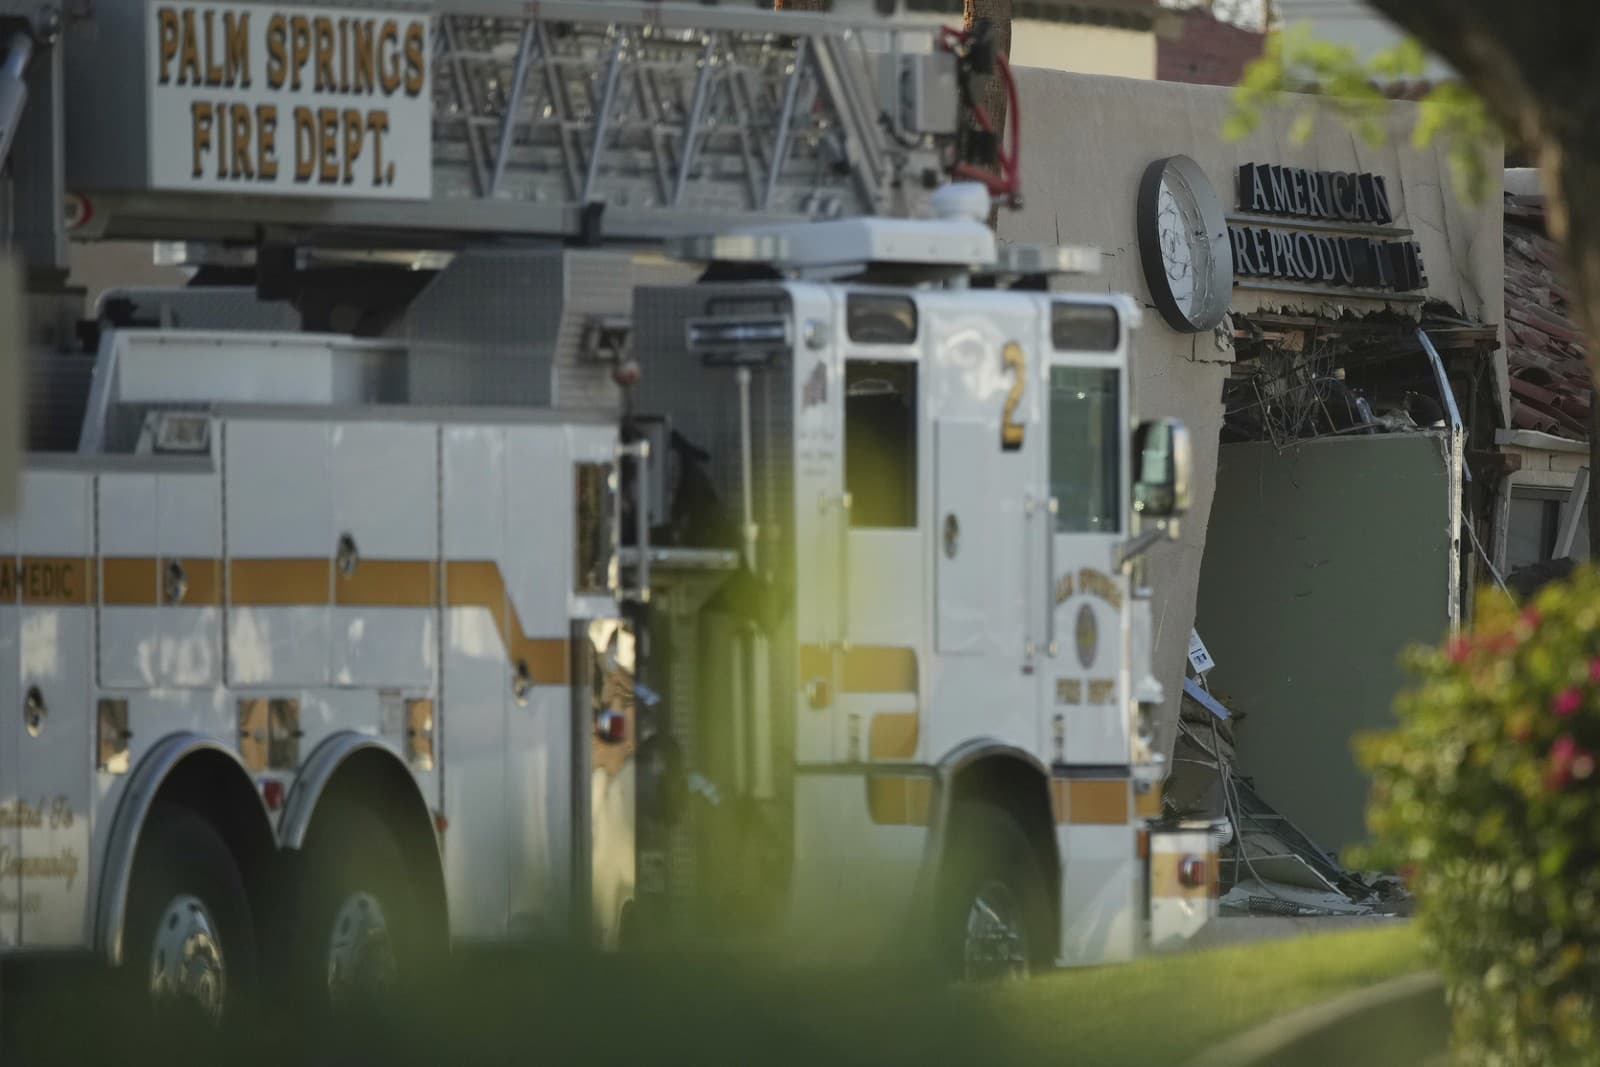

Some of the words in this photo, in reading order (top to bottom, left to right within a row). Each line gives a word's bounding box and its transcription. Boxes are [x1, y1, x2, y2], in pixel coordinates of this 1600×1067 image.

[157, 7, 252, 88] PALM
[266, 12, 425, 98] SPRINGS
[191, 100, 278, 181] FIRE
[293, 105, 395, 187] DEPT.
[1241, 162, 1392, 226] AMERICAN
[1001, 340, 1025, 451] 2
